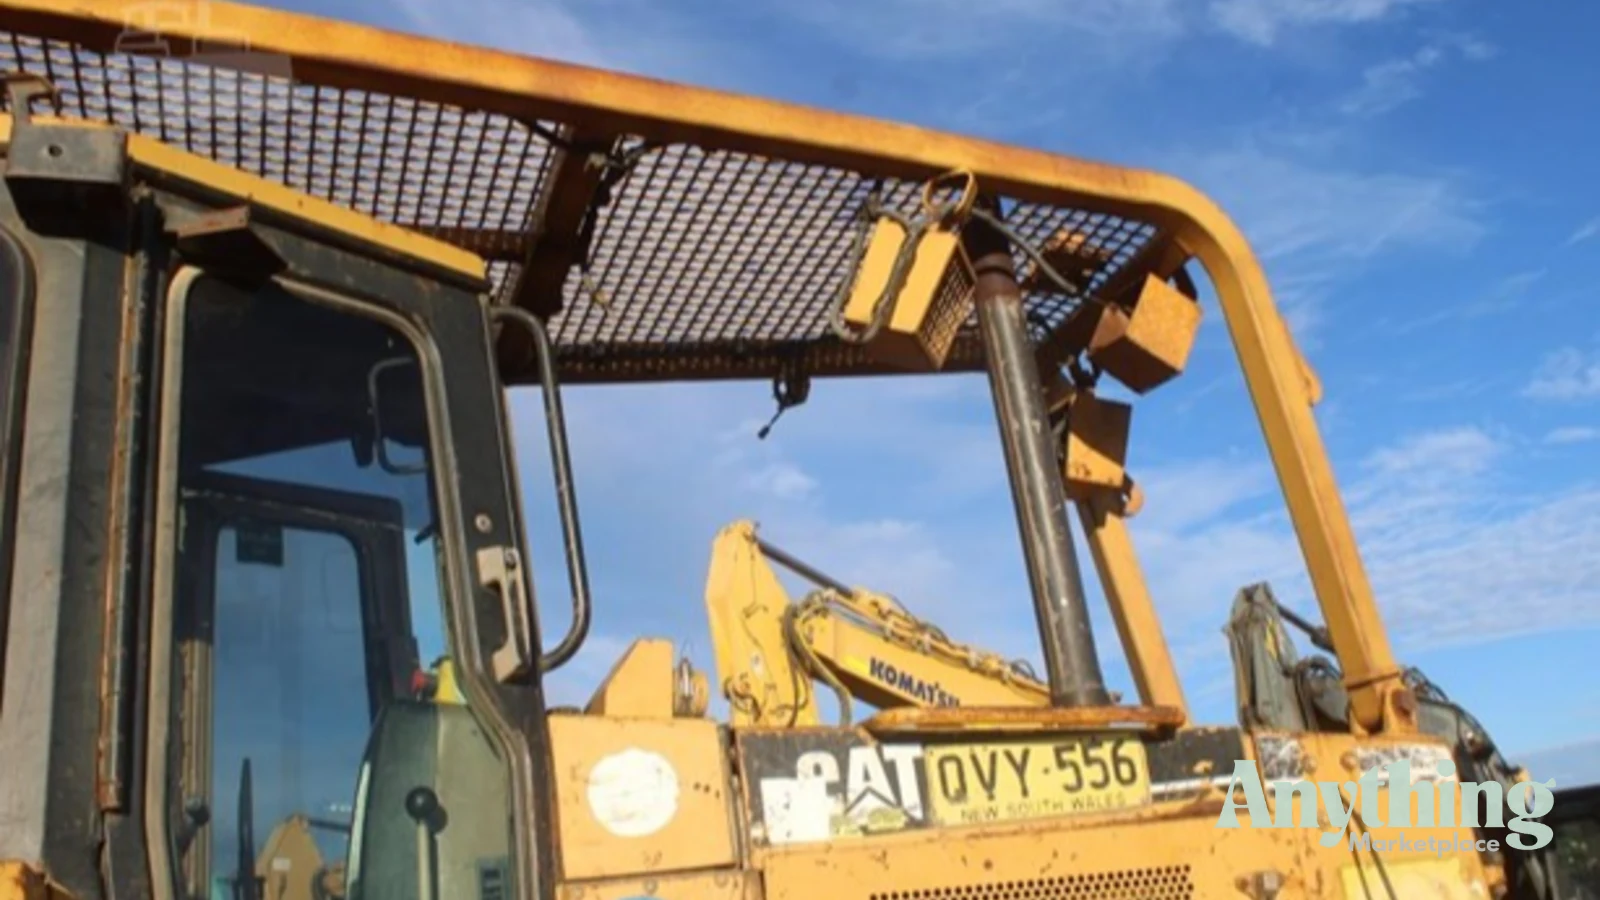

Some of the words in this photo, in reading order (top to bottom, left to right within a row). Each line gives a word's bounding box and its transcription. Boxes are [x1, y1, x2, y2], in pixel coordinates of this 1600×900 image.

[961, 807, 999, 823] NEW
[1007, 799, 1064, 817] SOUTH
[1072, 792, 1126, 811] WALES
